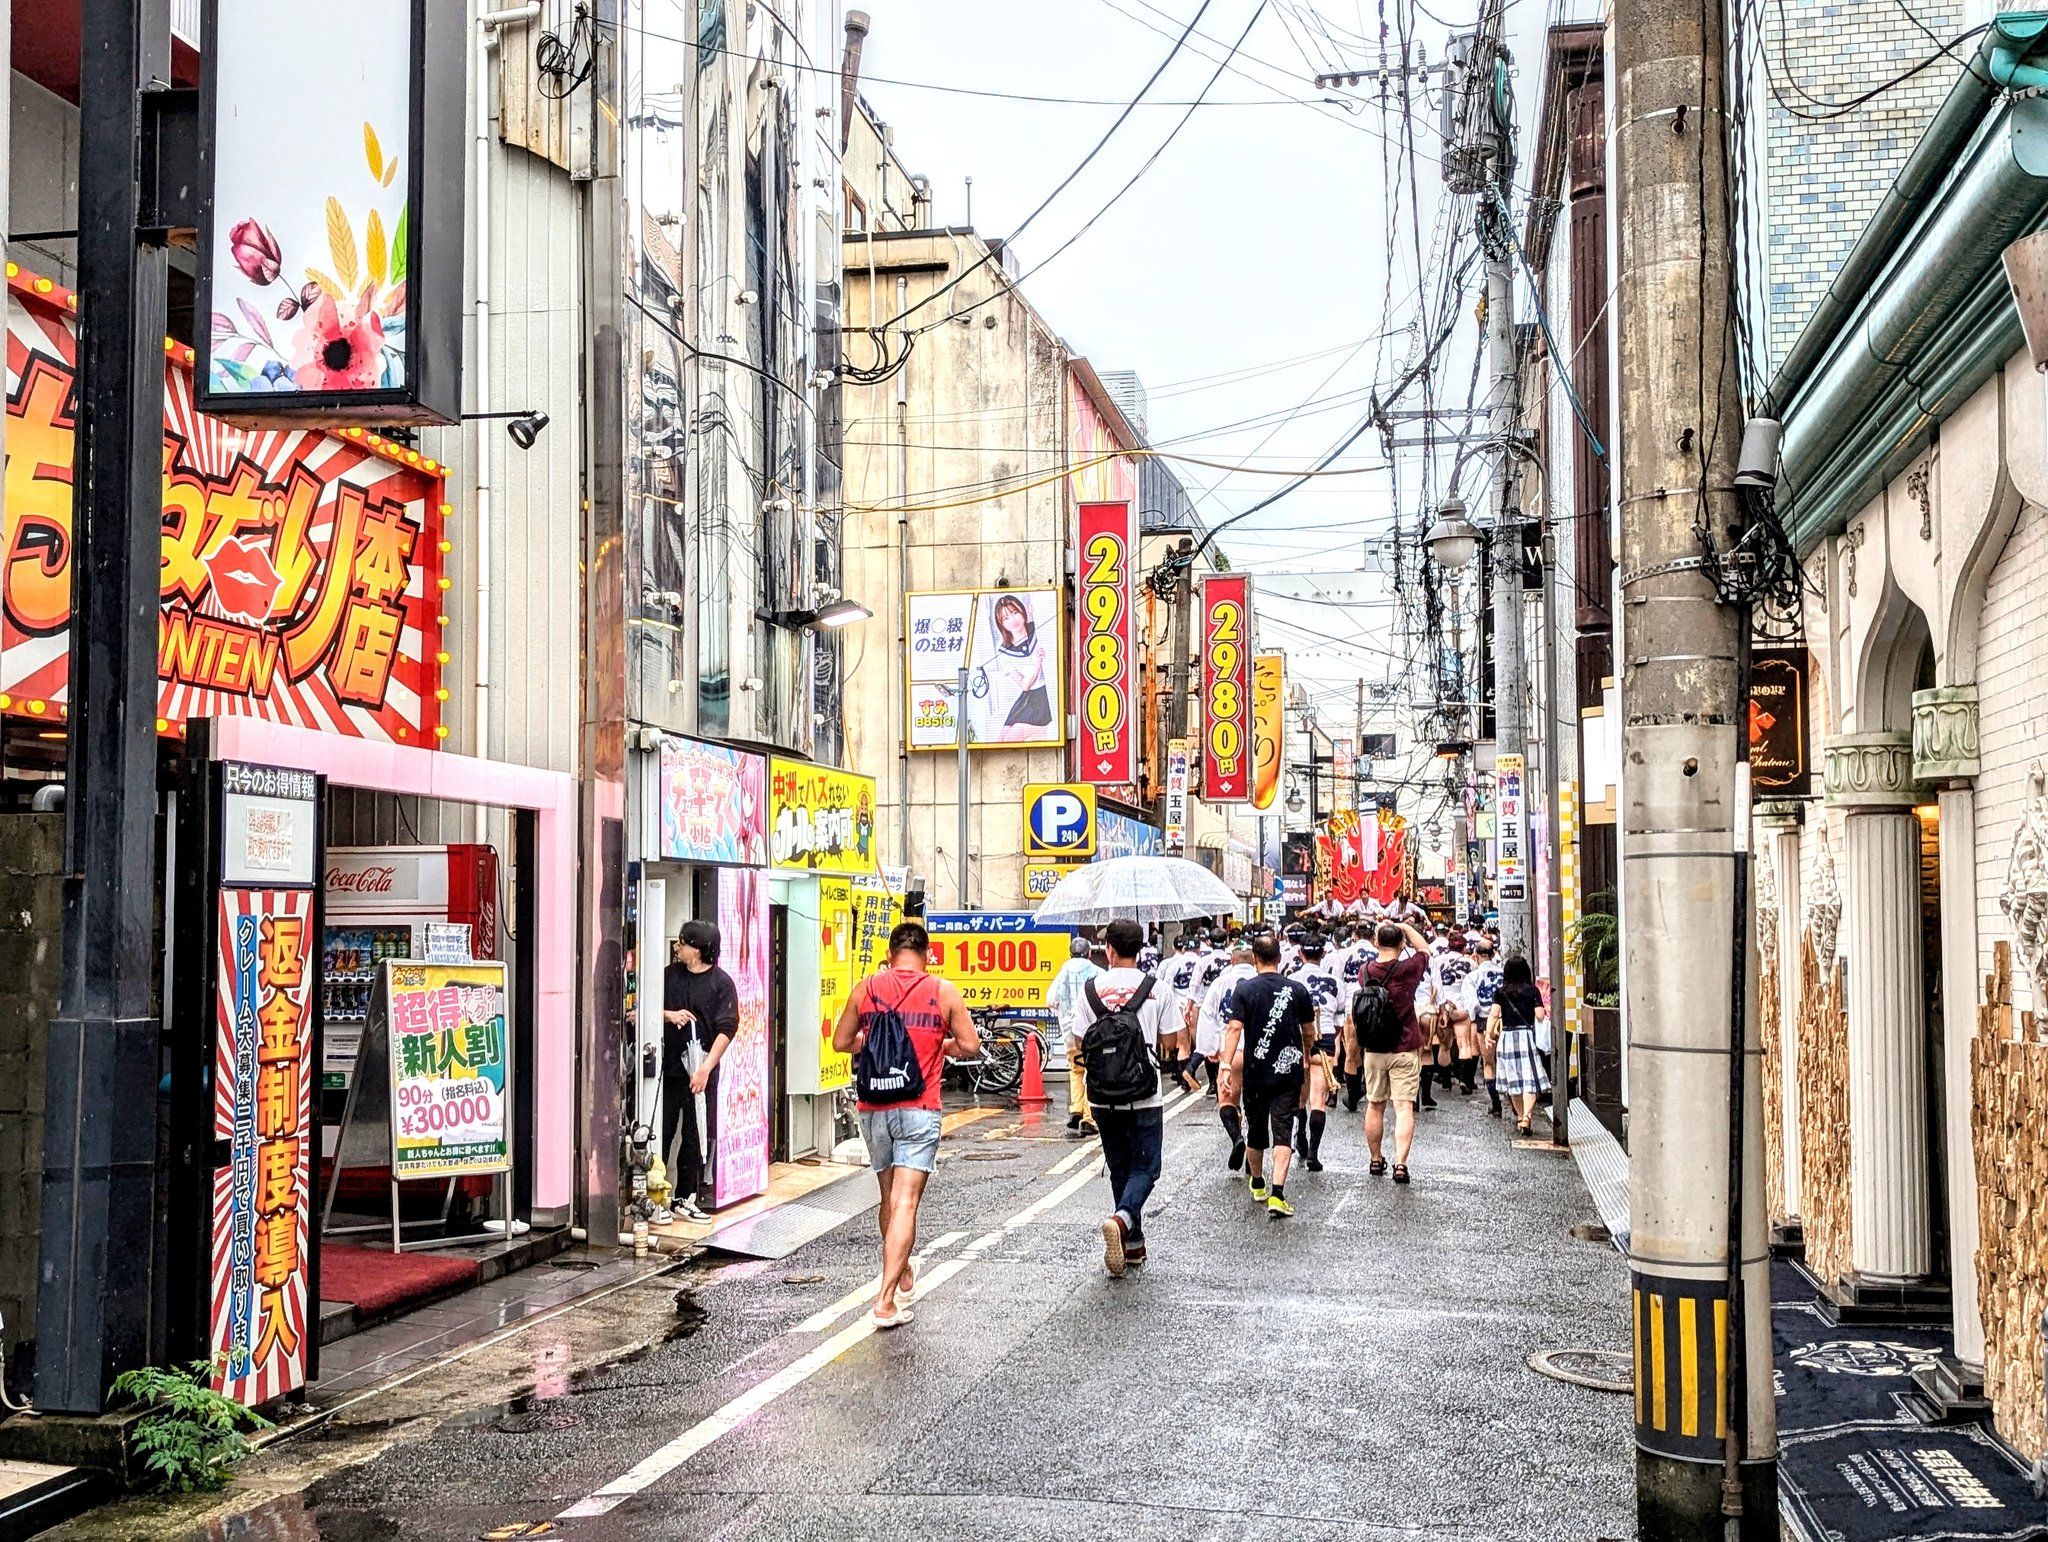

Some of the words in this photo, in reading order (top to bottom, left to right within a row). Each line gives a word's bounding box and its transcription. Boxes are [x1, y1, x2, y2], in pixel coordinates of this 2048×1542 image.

[335, 498, 420, 708] 本店
[915, 636, 963, 652] の逸材
[1086, 535, 1122, 753] 2980円
[1210, 602, 1241, 775] 2980円
[919, 700, 949, 716] すみ
[224, 764, 316, 799] 只今のお得情報
[773, 769, 850, 806] 中洲でハズれない
[1061, 829, 1078, 843] 24h
[1502, 822, 1519, 858] 玉屋
[325, 866, 397, 893] Coca-Cola
[955, 940, 1037, 976] 1,900
[1040, 960, 1052, 972] 円
[393, 987, 461, 1034] 超得
[461, 985, 496, 1003] チョウ
[962, 988, 977, 999] 20
[980, 987, 992, 999] 分
[1002, 988, 1025, 999] 200
[1028, 987, 1040, 1000] 円
[402, 1020, 501, 1078] 新人割
[398, 1084, 434, 1108] 90分
[869, 1075, 905, 1091] PUMA
[400, 1094, 491, 1136] ¥30,000
[252, 915, 304, 1371] 返金制度導入
